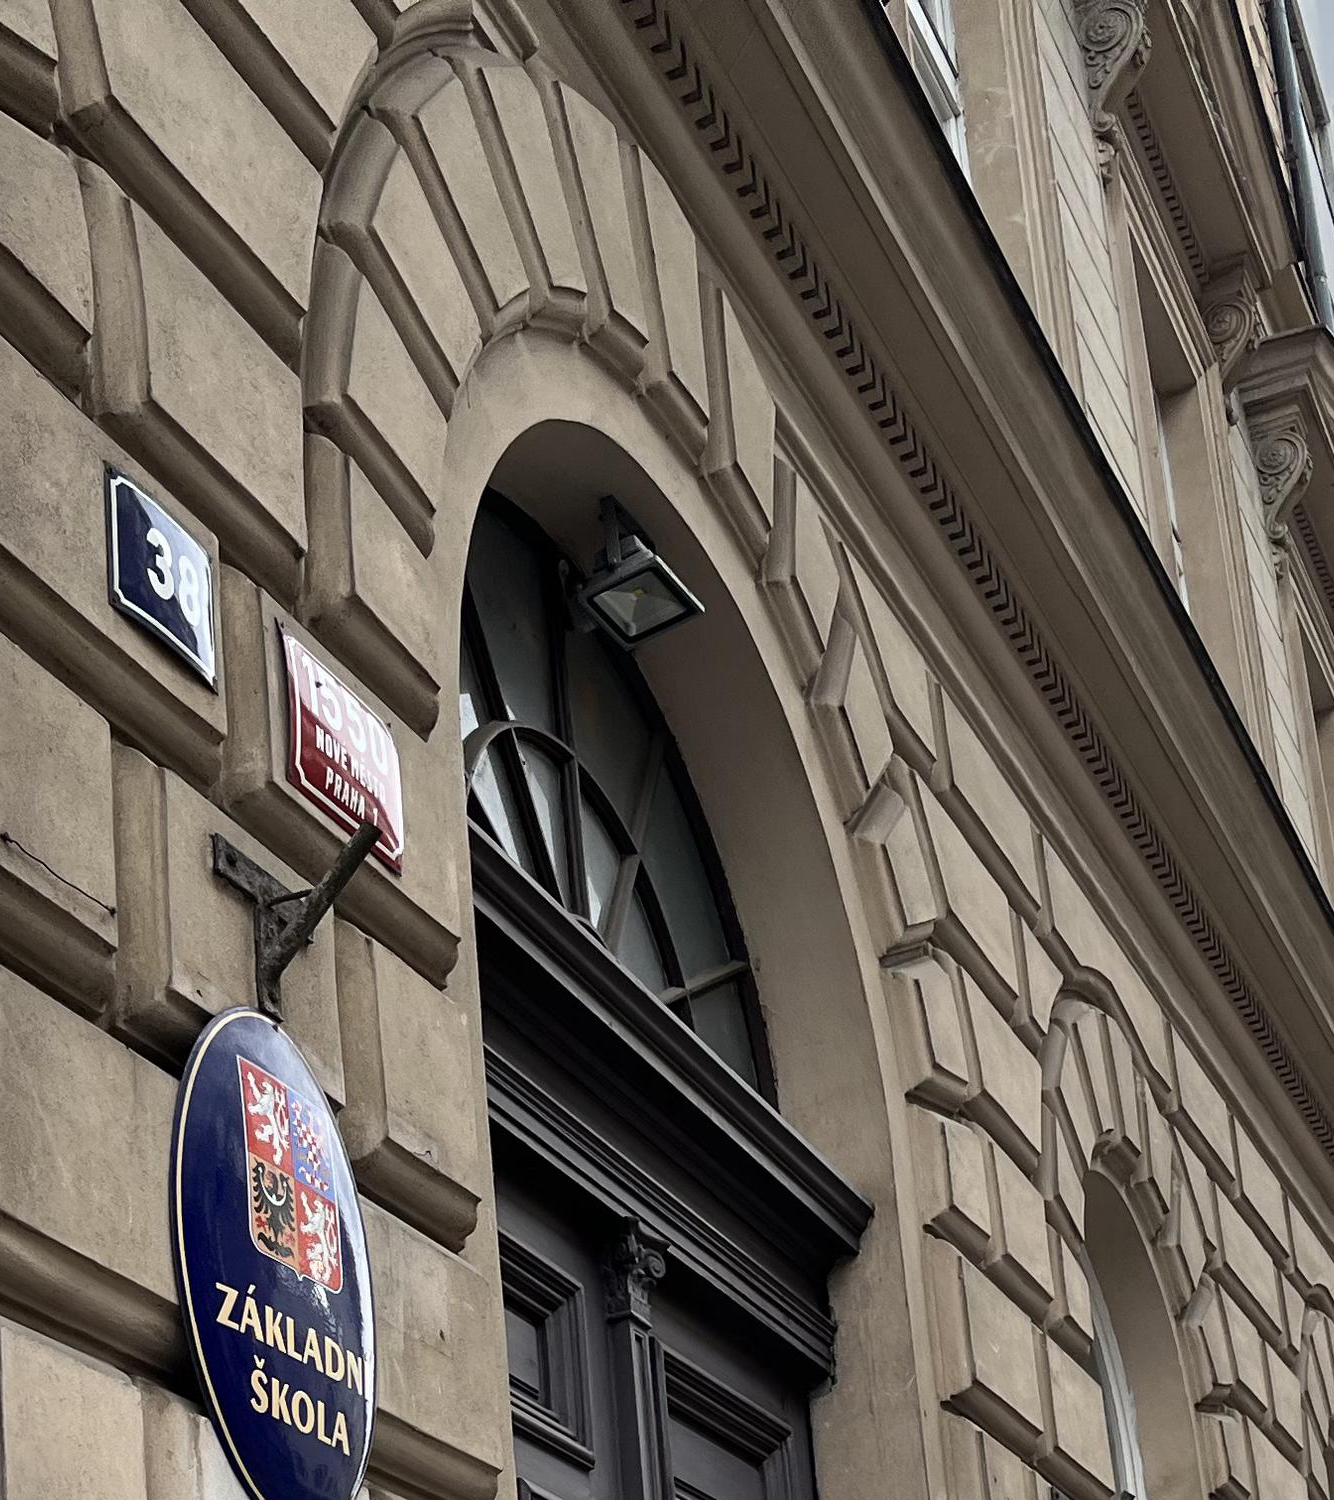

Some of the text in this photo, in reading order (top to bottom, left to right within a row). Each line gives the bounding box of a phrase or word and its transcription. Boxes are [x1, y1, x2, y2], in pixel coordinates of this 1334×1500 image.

[146, 527, 201, 627] 38
[301, 652, 388, 777] 1550
[325, 767, 378, 826] PRAHA 1
[250, 1354, 350, 1456] ŠKOLA
